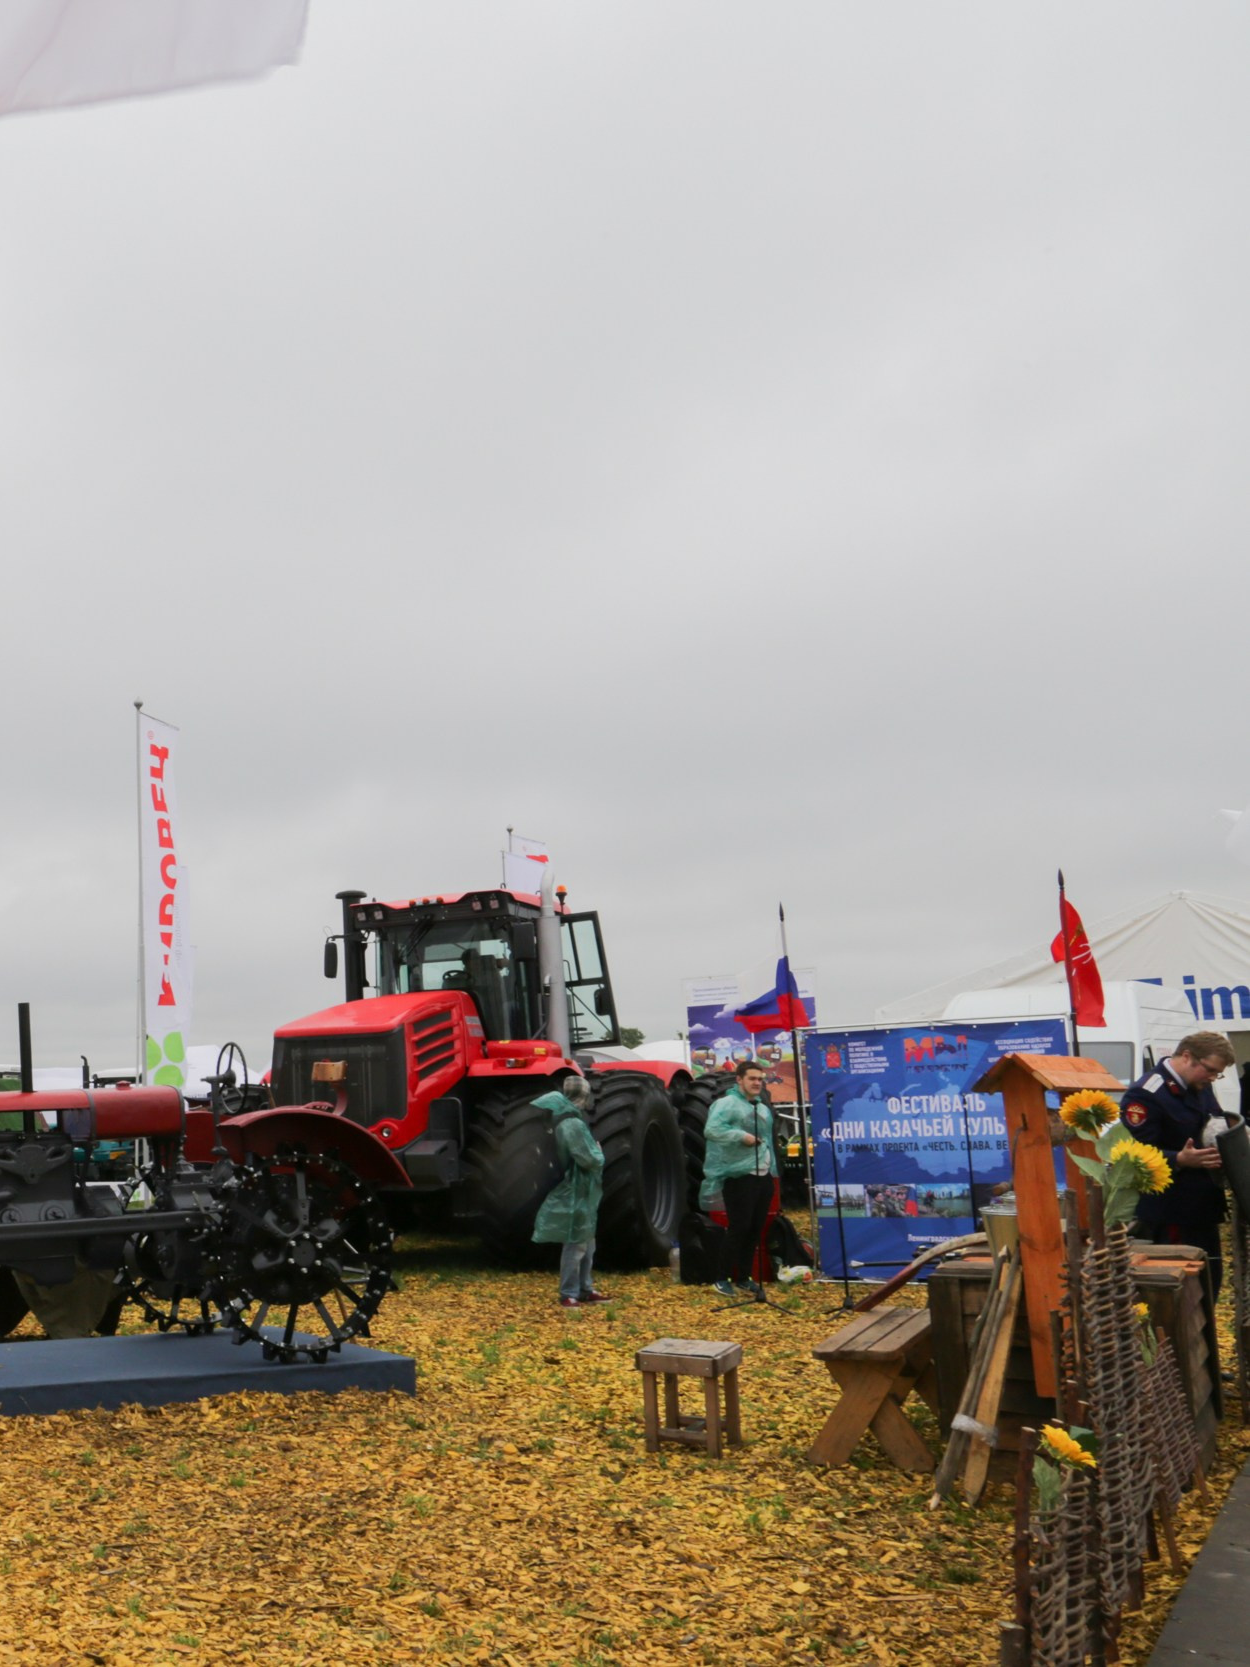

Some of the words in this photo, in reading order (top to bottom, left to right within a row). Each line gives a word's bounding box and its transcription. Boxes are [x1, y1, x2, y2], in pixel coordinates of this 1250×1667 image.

[887, 1093, 986, 1115] ФЕСТИВАЛЬ
[821, 1120, 866, 1142] «ДНИ
[870, 1113, 954, 1139] КАЗАЧЬЕЙ
[960, 1116, 1007, 1137] КУЛЬ
[882, 1142, 920, 1152] ПРОЕКТА
